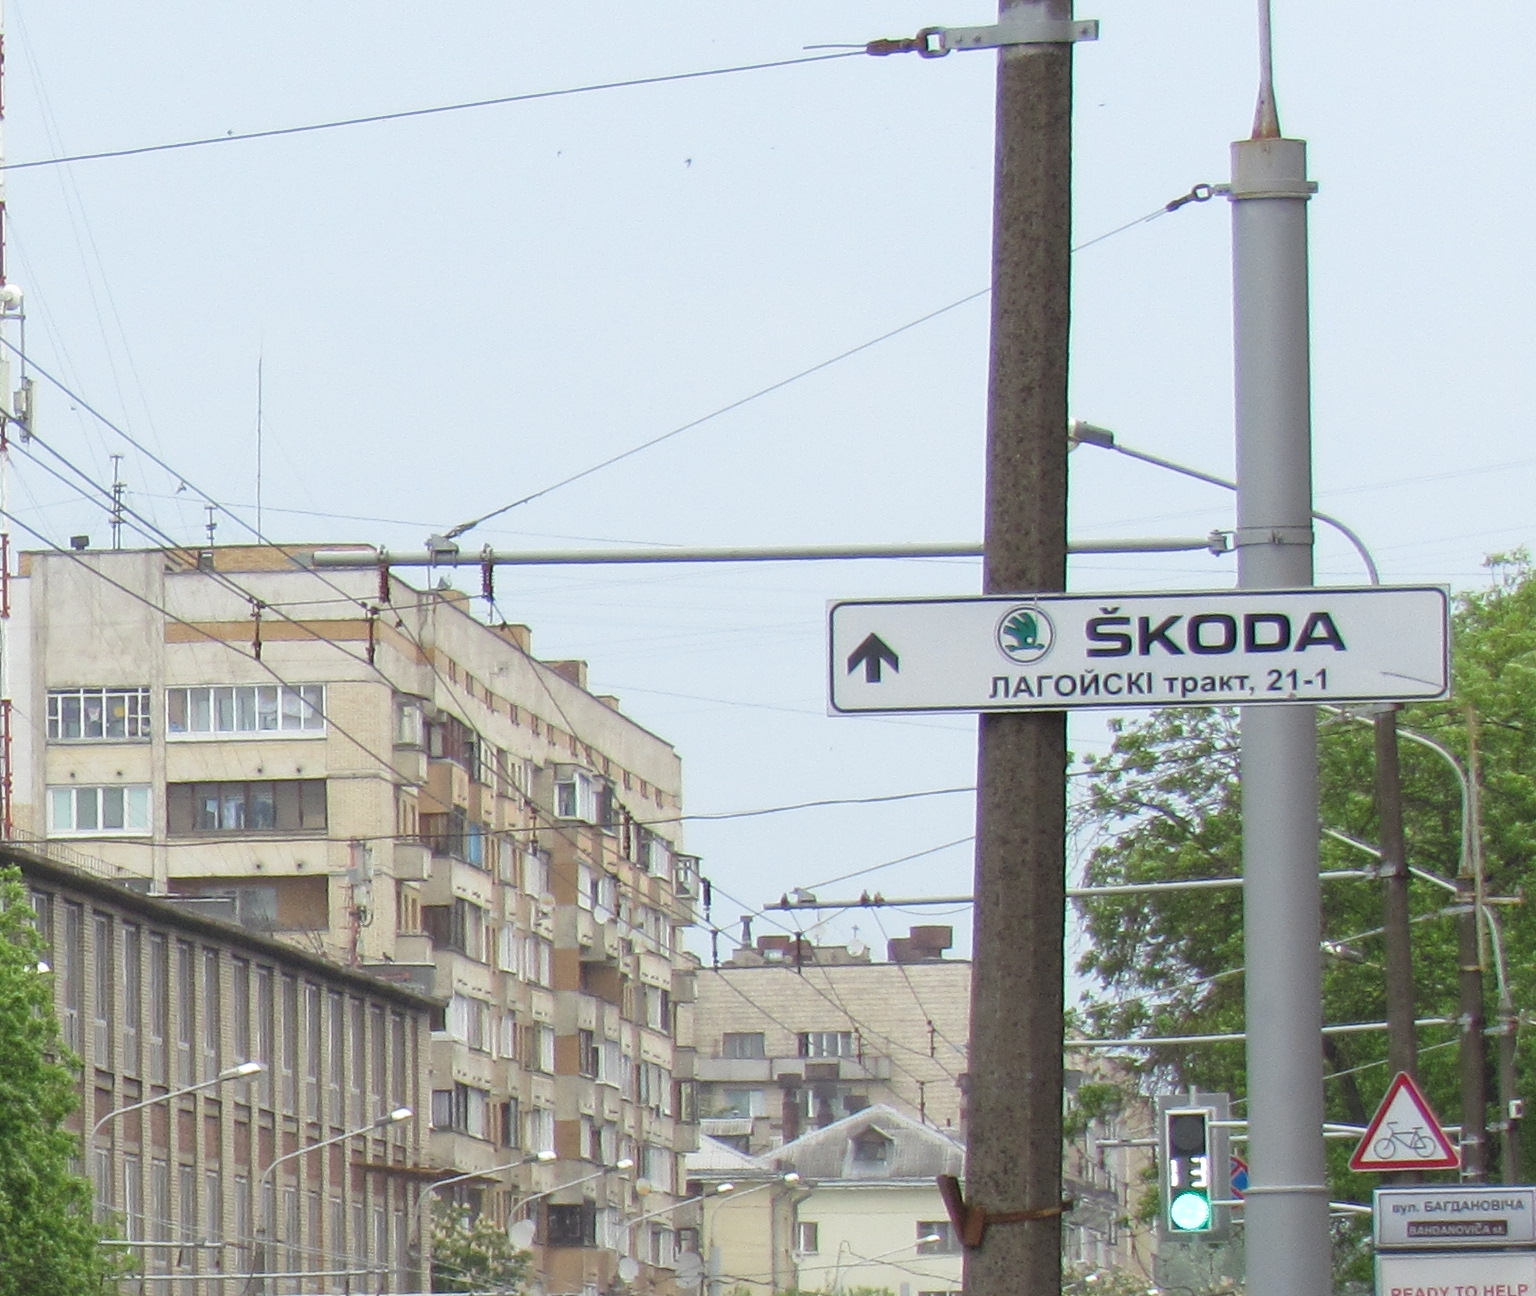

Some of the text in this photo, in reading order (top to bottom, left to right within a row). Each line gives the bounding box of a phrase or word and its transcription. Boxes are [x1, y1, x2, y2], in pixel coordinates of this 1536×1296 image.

[1086, 607, 1346, 658] ŠKODA
[989, 667, 1329, 700] ЛАГОЙСКІ тракт, 21-1
[1424, 1199, 1524, 1213] БАГДАНОВІЧА
